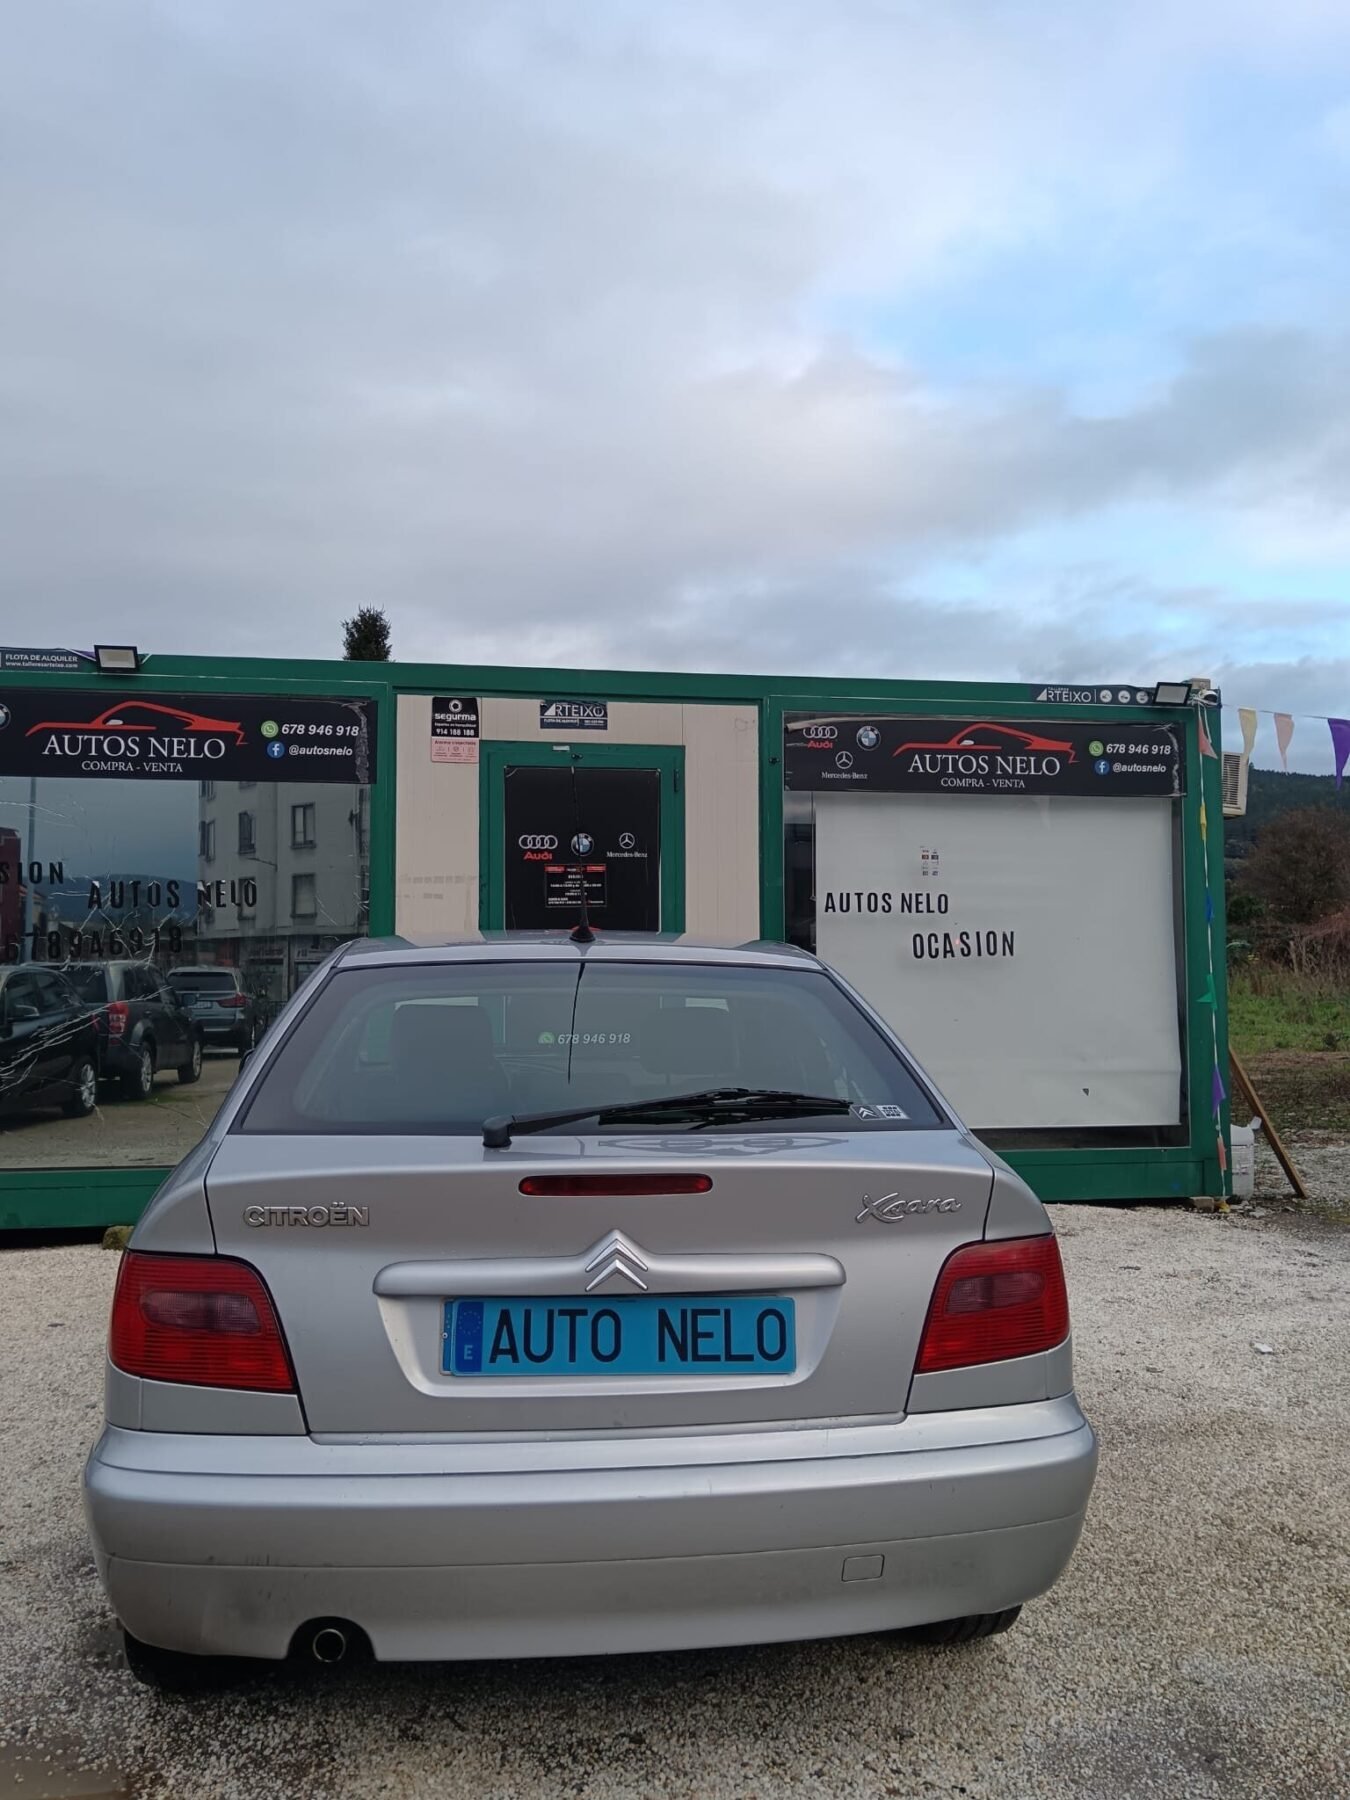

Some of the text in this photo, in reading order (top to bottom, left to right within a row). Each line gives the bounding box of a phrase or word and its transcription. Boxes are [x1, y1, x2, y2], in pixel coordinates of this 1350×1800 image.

[5, 653, 29, 661] FLOTA
[434, 713, 477, 721] segurma
[281, 724, 359, 737] 678 946 918
[41, 735, 226, 759] AUTOS NELO
[288, 744, 353, 756] @autosnelo
[807, 740, 833, 749] Audi
[1106, 743, 1171, 755] 678 946 918
[81, 760, 133, 773] COMPRA
[143, 763, 183, 773] VENTA
[908, 755, 1060, 776] AUTOS NELO
[1112, 763, 1167, 773] @autosnelo
[821, 771, 868, 779] Mercedes-Benz
[940, 777, 984, 788] COMPRA
[992, 780, 1026, 788] VENTA
[523, 851, 553, 860] Audi
[88, 879, 258, 909] AUTOS NELO
[824, 892, 949, 914] AUTOS NELO
[912, 931, 1015, 960] OCASION
[558, 1033, 631, 1044] 678 946 918
[856, 1192, 961, 1224] Xsara
[244, 1202, 369, 1227] CITROËN
[463, 1308, 787, 1364] E AUTO NELO
